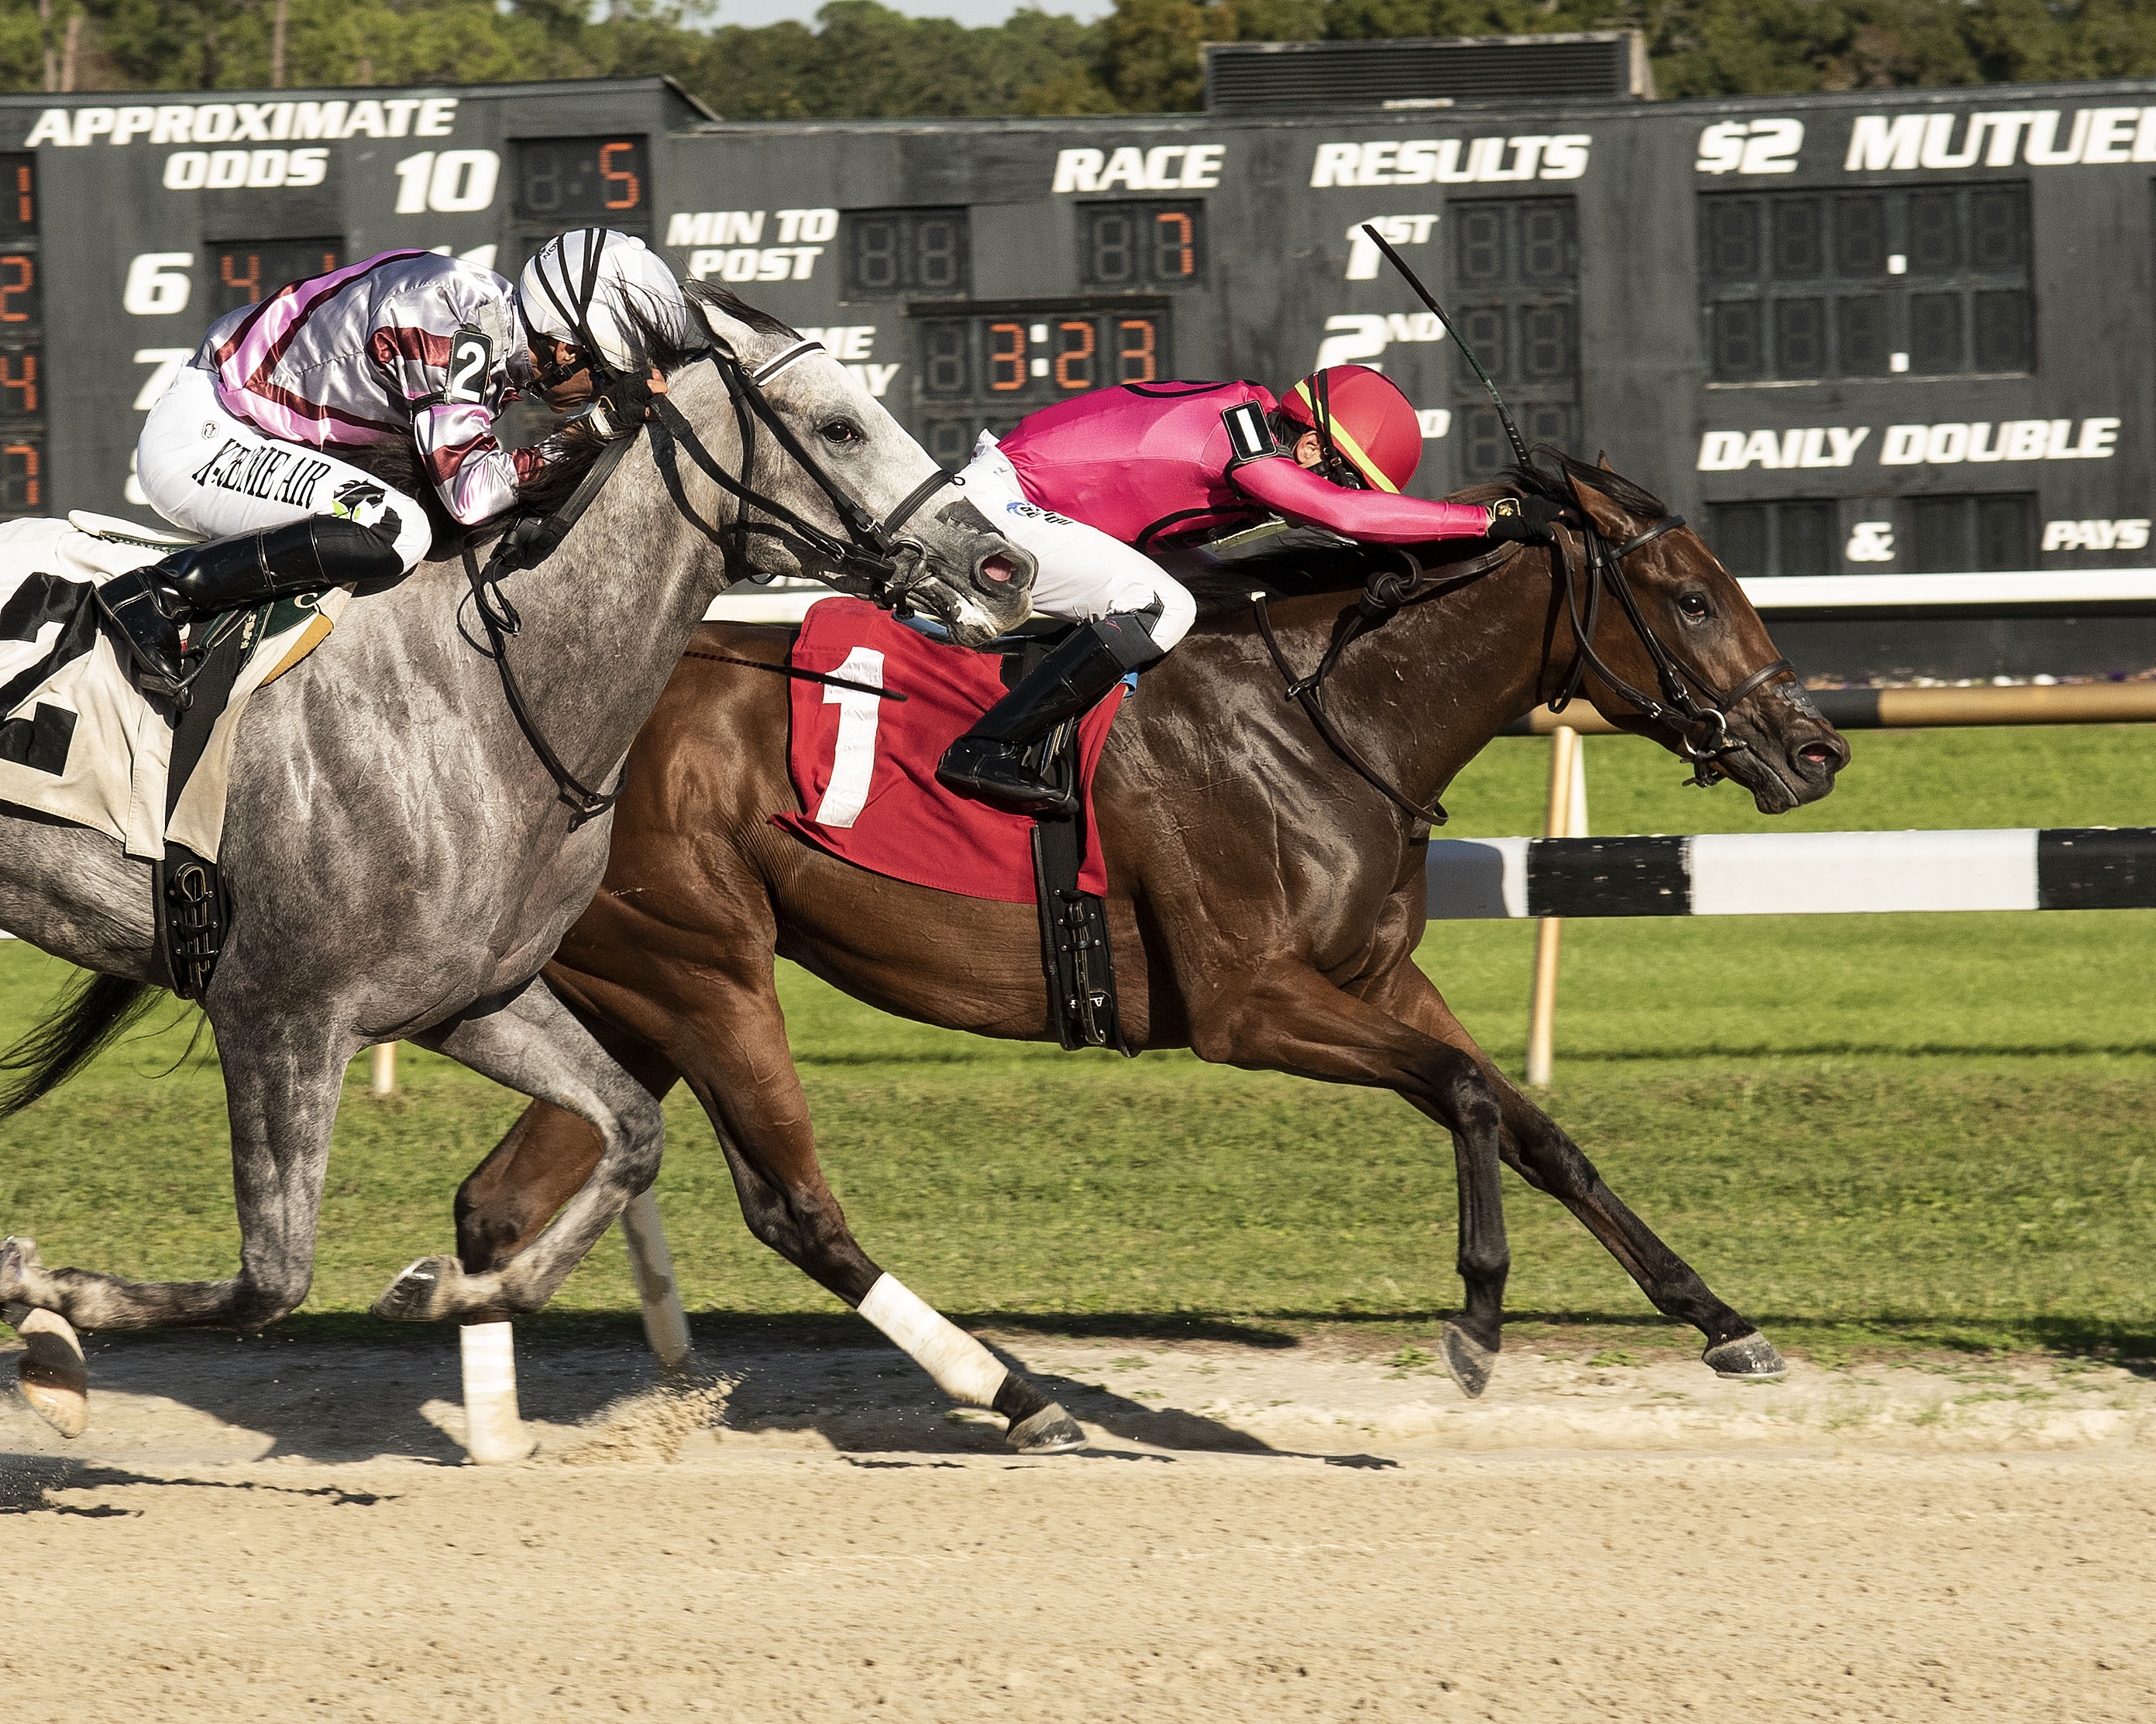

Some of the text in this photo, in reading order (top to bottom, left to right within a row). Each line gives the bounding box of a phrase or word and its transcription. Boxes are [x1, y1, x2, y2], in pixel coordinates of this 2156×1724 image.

[25, 98, 459, 147] APPROXIMATE
[1695, 118, 1805, 174] $2
[163, 147, 330, 190] ODDS
[394, 149, 500, 214] 10
[599, 142, 640, 210] 5
[1052, 144, 1226, 193] RACE
[1310, 134, 1593, 187] RESULTS
[665, 208, 840, 246] MIN TO
[1157, 211, 1194, 275] 7
[1345, 214, 1440, 280] 1ST
[123, 252, 194, 315] 6
[687, 246, 825, 283] POST
[132, 349, 195, 410] 7
[451, 341, 487, 404] 2
[990, 319, 1156, 389] 3:23
[1235, 407, 1263, 453] 1
[1697, 417, 2121, 471] DAILY DOUBLE
[273, 457, 331, 510] AIR
[2042, 519, 2151, 551] PAYS
[815, 646, 885, 828] 1
